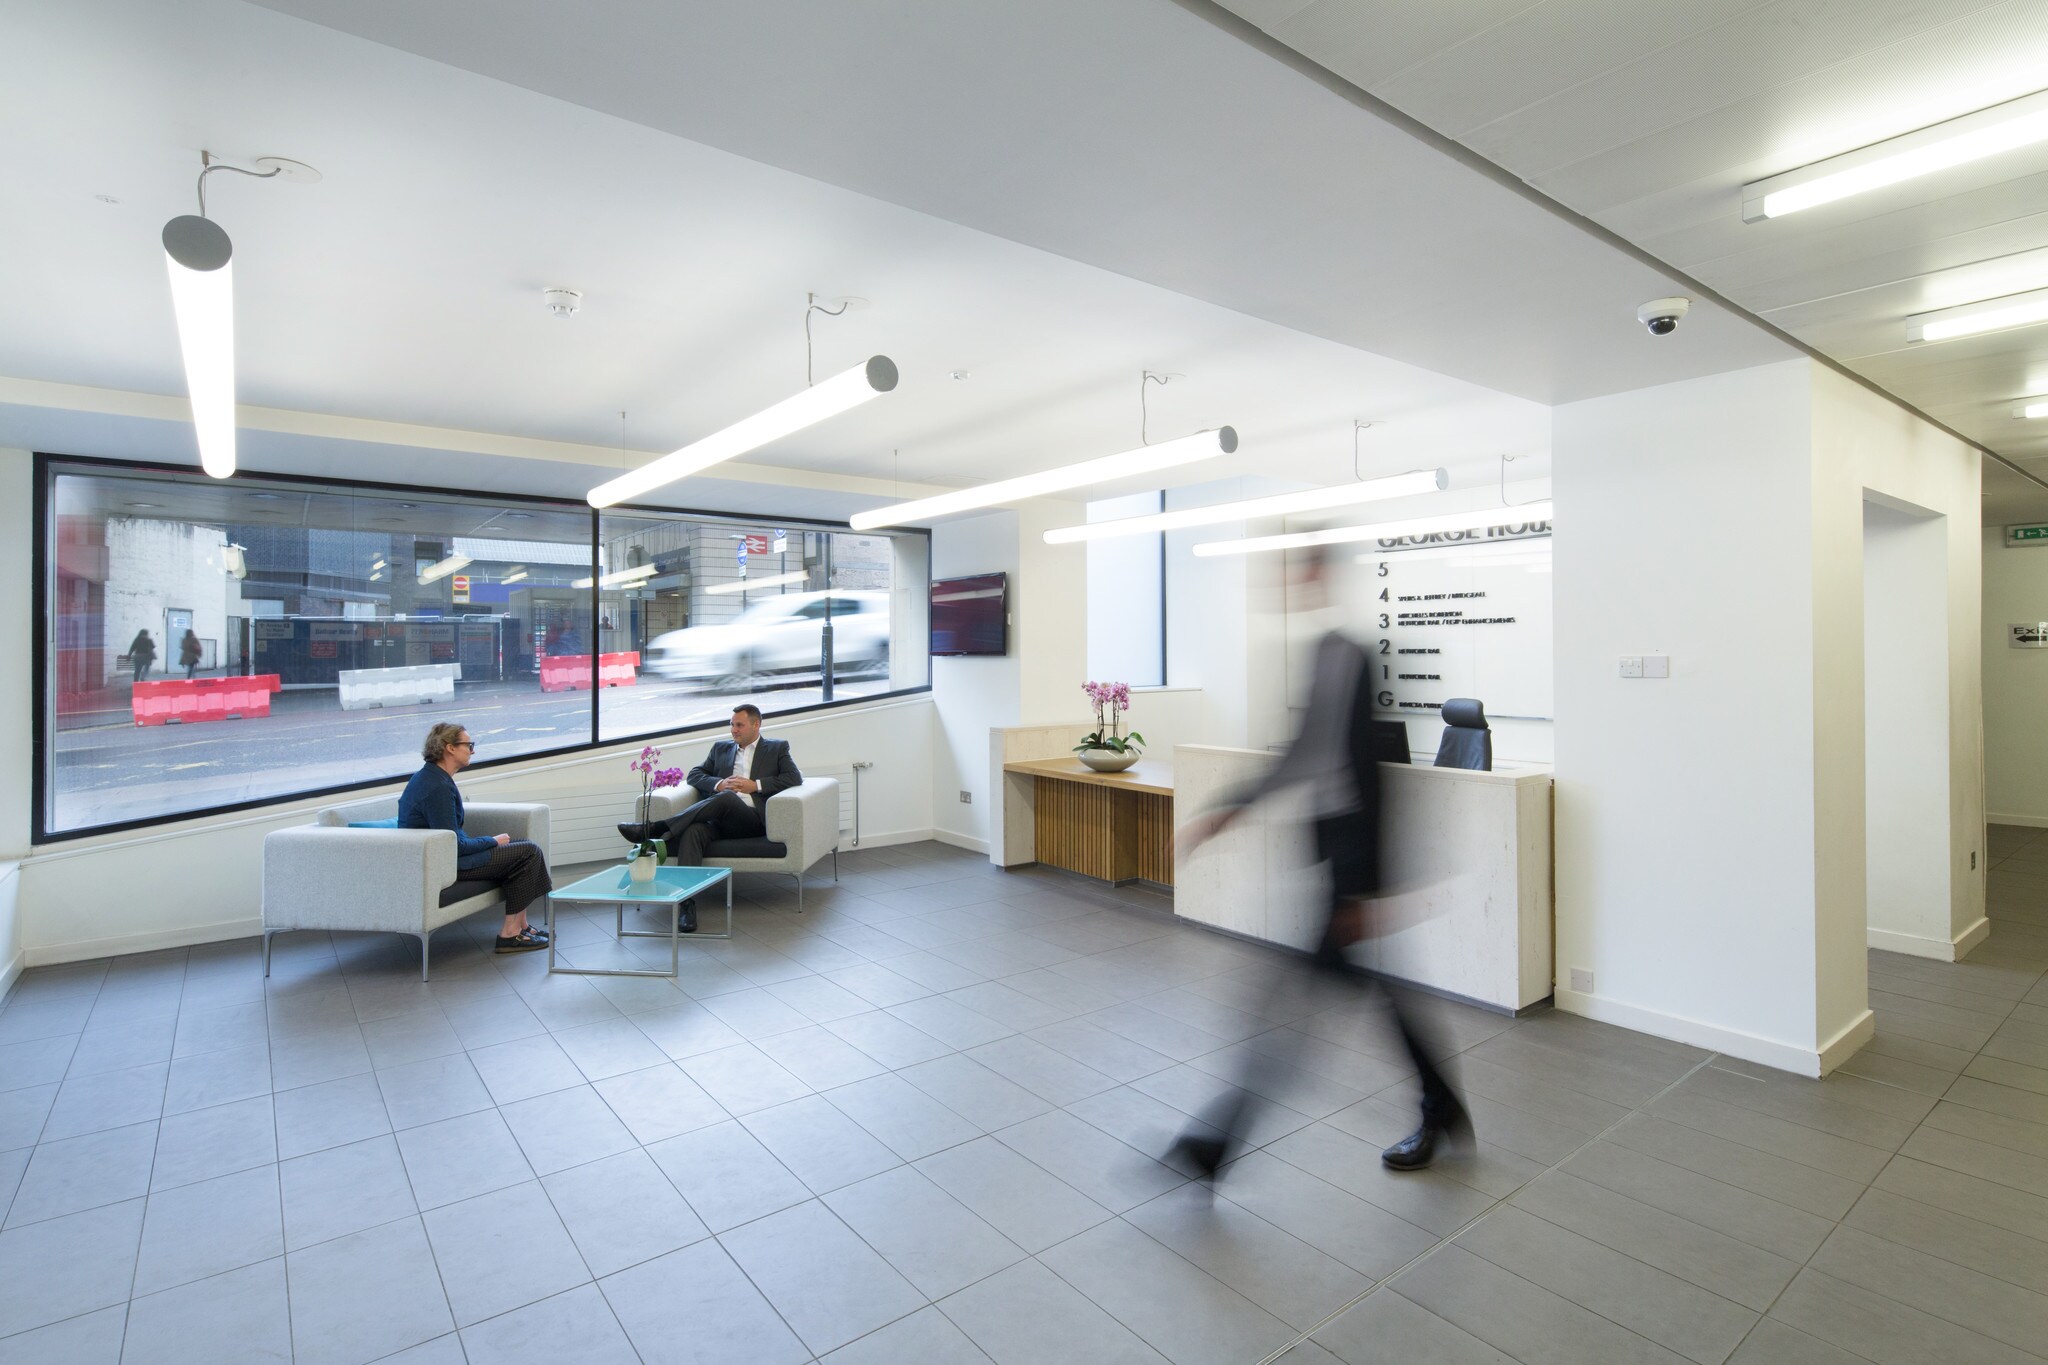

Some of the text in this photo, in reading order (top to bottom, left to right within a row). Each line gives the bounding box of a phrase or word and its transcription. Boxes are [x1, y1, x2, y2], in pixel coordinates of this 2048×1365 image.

[1377, 562, 1389, 577] 5
[1379, 587, 1390, 602] 4
[1379, 613, 1390, 629] 3
[1379, 639, 1391, 655] 2
[1382, 664, 1389, 680] 1
[1377, 691, 1394, 707] G
